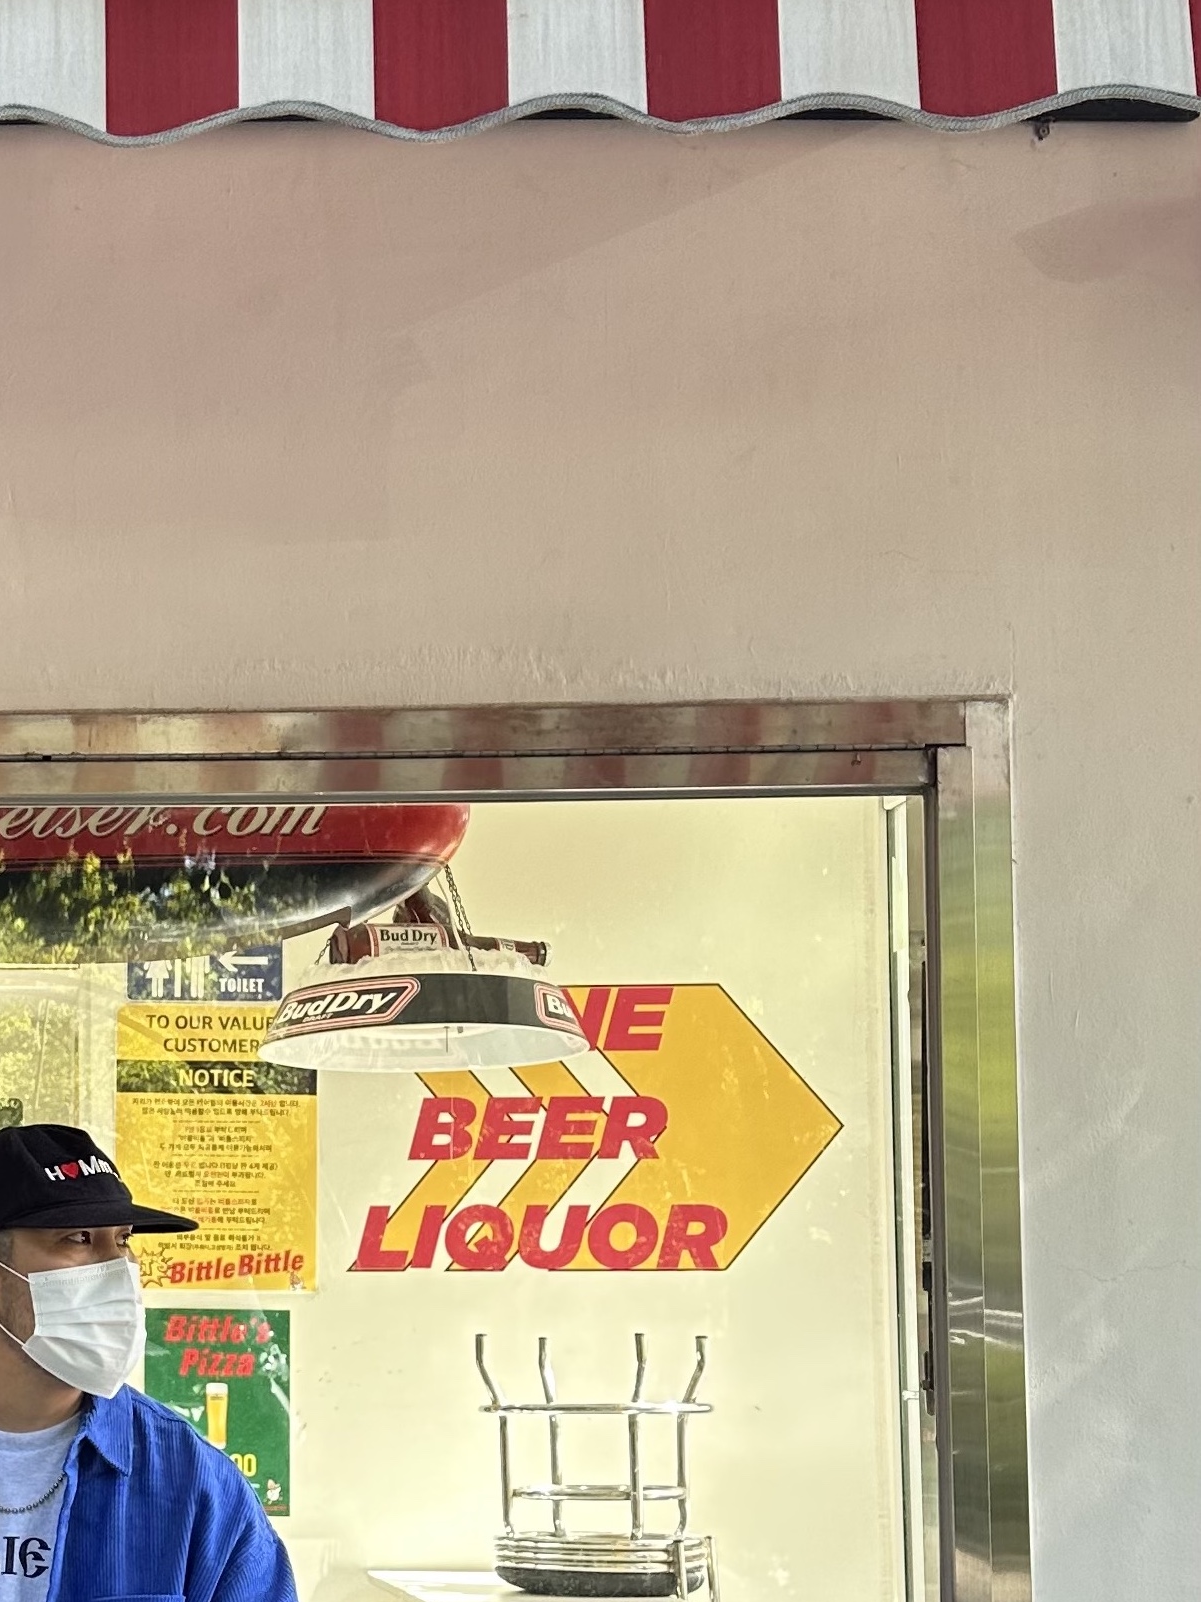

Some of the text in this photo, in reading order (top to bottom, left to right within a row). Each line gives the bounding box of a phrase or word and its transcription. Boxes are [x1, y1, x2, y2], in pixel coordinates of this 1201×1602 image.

[380, 929, 438, 945] Bud Dry
[219, 978, 264, 993] TOILET
[146, 1015, 169, 1029] TO
[175, 1015, 212, 1030] OUR
[178, 1069, 256, 1088] NOTICE
[408, 1096, 669, 1160] BEER
[355, 1204, 729, 1270] LIQUOR
[164, 1315, 272, 1344] Bittle's
[180, 1347, 255, 1377] Pizza
